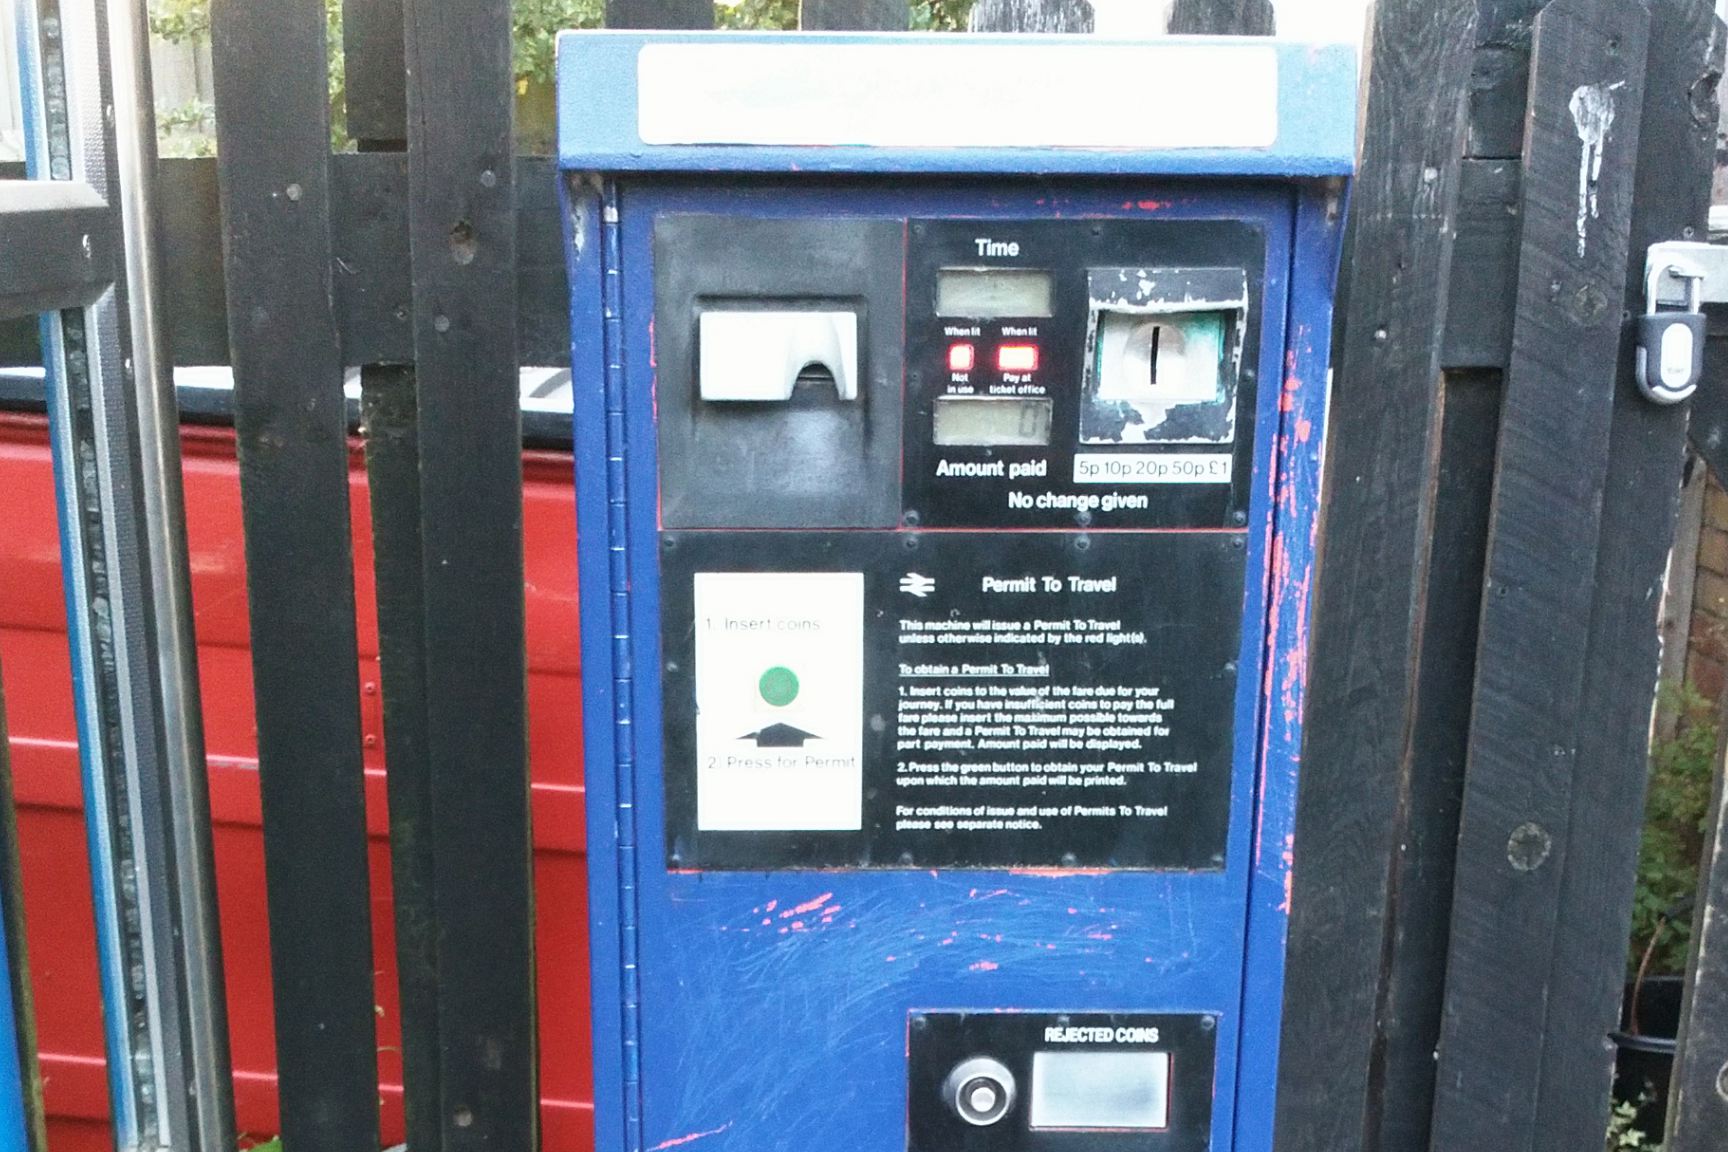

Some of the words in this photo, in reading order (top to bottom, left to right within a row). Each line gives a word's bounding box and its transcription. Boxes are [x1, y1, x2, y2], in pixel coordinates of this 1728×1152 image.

[975, 238, 1020, 256] Time
[944, 327, 970, 336] When
[971, 327, 980, 336] lit
[1002, 327, 1028, 336] When
[1029, 327, 1037, 336] lit
[952, 373, 969, 382] Not
[1003, 373, 1019, 384] Pay
[1021, 374, 1031, 382] at
[947, 385, 956, 394] in
[957, 386, 974, 394] use
[989, 385, 1016, 394] ticket
[1018, 385, 1045, 394] office
[936, 459, 1004, 477] Amount
[1009, 459, 1047, 479] paid
[1079, 460, 1099, 476] 5p
[1105, 460, 1131, 476] 10p
[1136, 460, 1167, 476] 20p
[1172, 460, 1204, 476] 50p
[1008, 492, 1033, 509] No
[1036, 492, 1099, 512] change
[1102, 492, 1148, 511] given
[982, 576, 1036, 592] Permit
[1042, 576, 1062, 592] To
[1068, 576, 1117, 592] Travel
[725, 618, 771, 630] Insert
[777, 620, 820, 630] coins
[899, 620, 923, 630] This
[925, 620, 970, 630] machine
[973, 620, 991, 630] will
[992, 620, 1021, 630] issue
[1023, 622, 1031, 630] a
[1034, 619, 1071, 631] Permit
[1073, 620, 1086, 630] To
[1088, 619, 1120, 630] Travel
[899, 633, 935, 643] unless
[937, 633, 992, 643] otherwise
[994, 633, 1045, 643] indicated
[1047, 633, 1062, 645] by
[1064, 633, 1083, 643] the
[1085, 633, 1103, 643] red
[1106, 632, 1147, 645] light(s).
[899, 664, 912, 676] To
[914, 664, 949, 676] obtain
[951, 666, 959, 676] a
[962, 664, 997, 676] Permit
[1001, 664, 1014, 676] To
[1016, 664, 1049, 677] Travel
[898, 687, 908, 696] 1.
[910, 687, 941, 696] Insert
[943, 687, 973, 696] coins
[975, 687, 986, 696] to
[989, 687, 1007, 696] the
[1009, 687, 1037, 696] value
[1038, 687, 1050, 696] of
[1052, 686, 1070, 696] the
[1072, 686, 1093, 696] fare
[1095, 686, 1116, 696] due
[1117, 686, 1133, 696] for
[1135, 687, 1159, 698] your
[898, 700, 942, 711] journey.
[944, 700, 953, 709] If
[955, 701, 975, 711] you
[977, 700, 1003, 709] have
[1004, 699, 1065, 710] insufficient
[1068, 700, 1098, 709] coins
[1100, 700, 1111, 709] to
[1113, 701, 1133, 711] pay
[1136, 700, 1154, 709] the
[1156, 699, 1174, 709] full
[898, 713, 919, 723] fare
[921, 713, 957, 724] please
[960, 713, 992, 723] insert
[994, 713, 1012, 723] the
[1013, 713, 1066, 723] maximum
[1069, 713, 1116, 724] possible
[1118, 713, 1162, 723] towards
[898, 726, 916, 736] the
[918, 726, 941, 736] fare
[943, 726, 963, 736] and
[965, 728, 972, 736] a
[975, 726, 1011, 736] Permit
[1013, 726, 1026, 736] To
[1027, 726, 1060, 736] Travel
[1062, 728, 1085, 737] may
[1087, 726, 1101, 736] be
[1103, 726, 1151, 736] obtained
[1154, 726, 1170, 736] for
[897, 740, 921, 750] part
[924, 740, 974, 750] payment.
[978, 740, 1020, 749] Amount
[1023, 740, 1048, 750] paid
[1049, 740, 1068, 749] will
[1069, 740, 1083, 749] be
[1086, 739, 1142, 750] displayed.
[727, 756, 772, 769] Press
[778, 756, 797, 769] for
[805, 756, 855, 769] Permit
[897, 762, 908, 772] 2.
[909, 762, 939, 772] Press
[941, 762, 959, 772] the
[960, 764, 991, 774] green
[993, 762, 1029, 772] button
[1031, 762, 1042, 772] to
[1044, 762, 1078, 772] obtain
[1080, 764, 1105, 774] your
[1107, 762, 1144, 772] Permit
[1147, 762, 1161, 772] To
[1163, 762, 1197, 772] Travel
[896, 777, 925, 787] upon
[926, 776, 957, 785] which
[960, 776, 977, 785] the
[979, 776, 1020, 785] amount
[1023, 776, 1047, 786] paid
[1049, 776, 1067, 785] will
[1068, 776, 1082, 785] be
[1084, 776, 1127, 787] printed.
[896, 806, 915, 816] For
[916, 806, 972, 816] conditions
[973, 806, 986, 816] of
[987, 807, 1015, 816] issue
[1016, 806, 1037, 816] and
[1039, 808, 1058, 816] use
[1060, 806, 1072, 816] of
[1074, 806, 1116, 816] Permits
[1119, 806, 1132, 816] To
[1134, 806, 1168, 816] Travel
[896, 820, 931, 830] please
[934, 821, 954, 829] see
[956, 820, 1003, 830] separate
[1005, 820, 1042, 829] notice.
[1044, 1027, 1114, 1042] REJECTED
[1116, 1027, 1159, 1043] COINS
